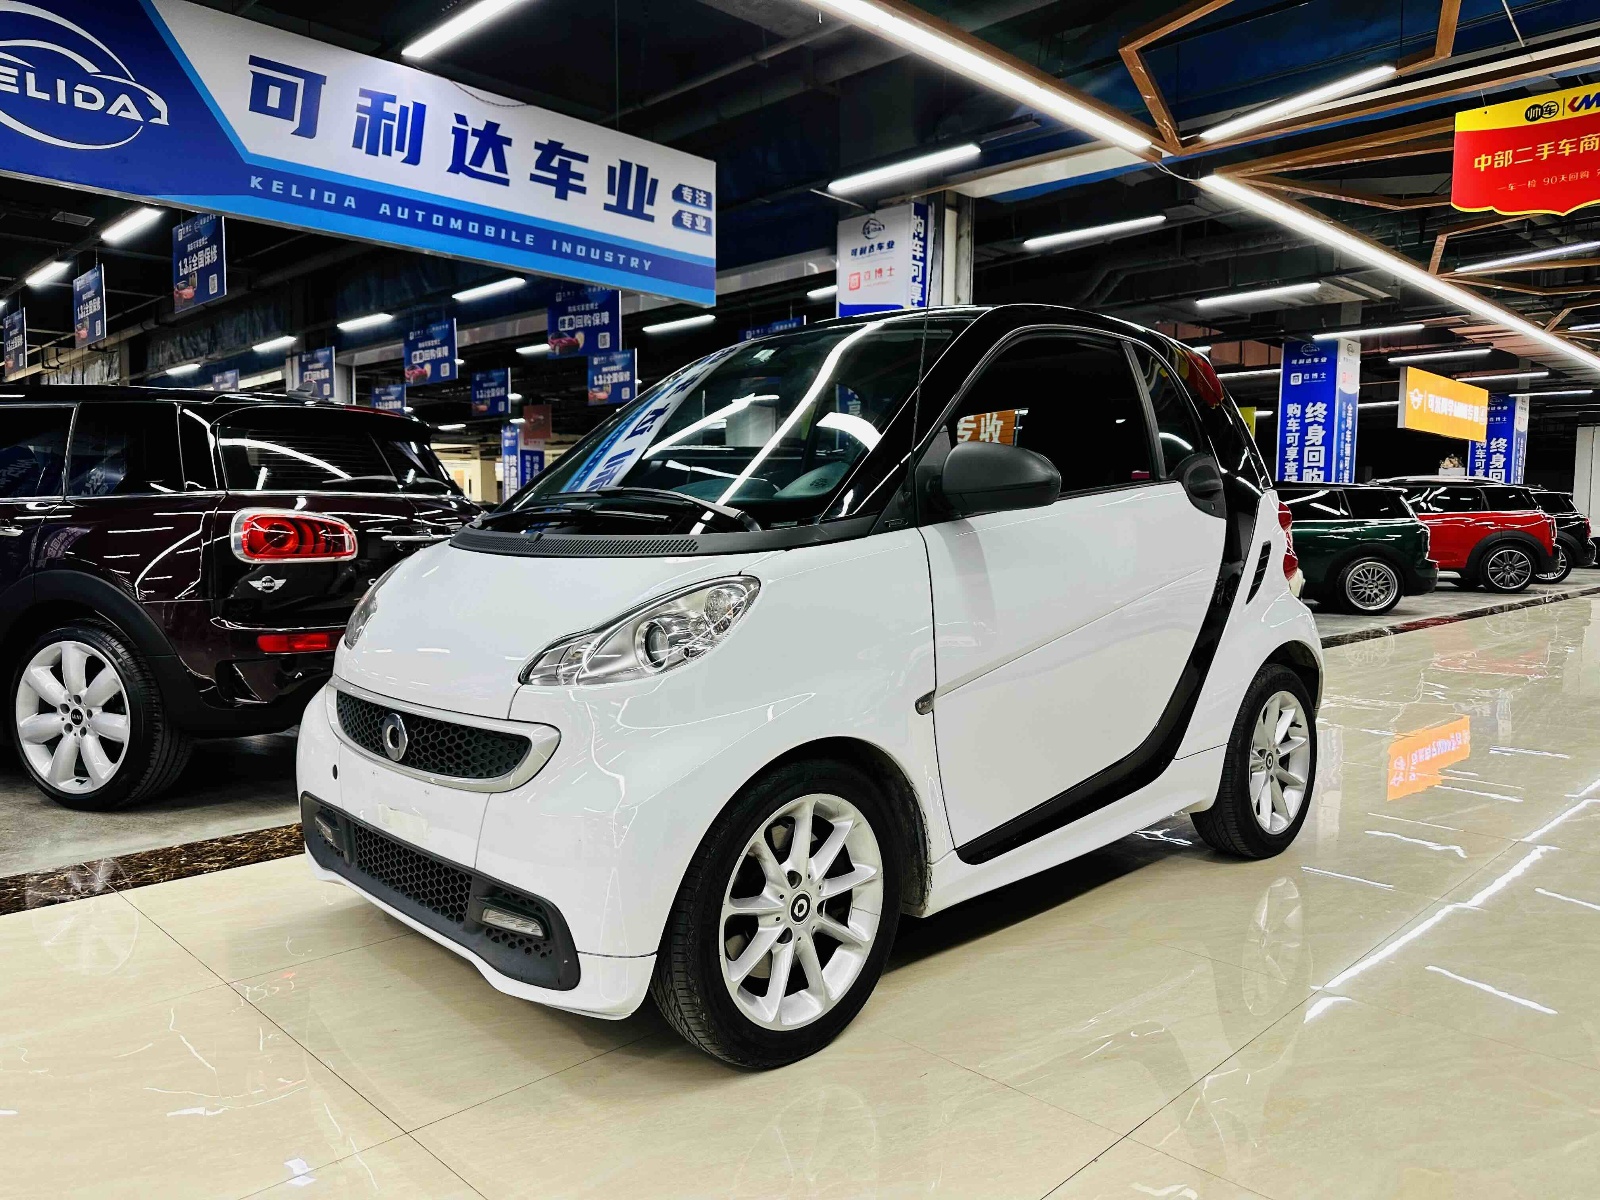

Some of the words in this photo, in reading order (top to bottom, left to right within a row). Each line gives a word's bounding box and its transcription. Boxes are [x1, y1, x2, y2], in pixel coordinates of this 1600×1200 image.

[249, 54, 658, 223] 可利达车业
[251, 175, 356, 210] KELIDA
[379, 203, 536, 246] AUTOMOBILE
[551, 239, 653, 271] INDUSTRY
[680, 211, 707, 233] 专业
